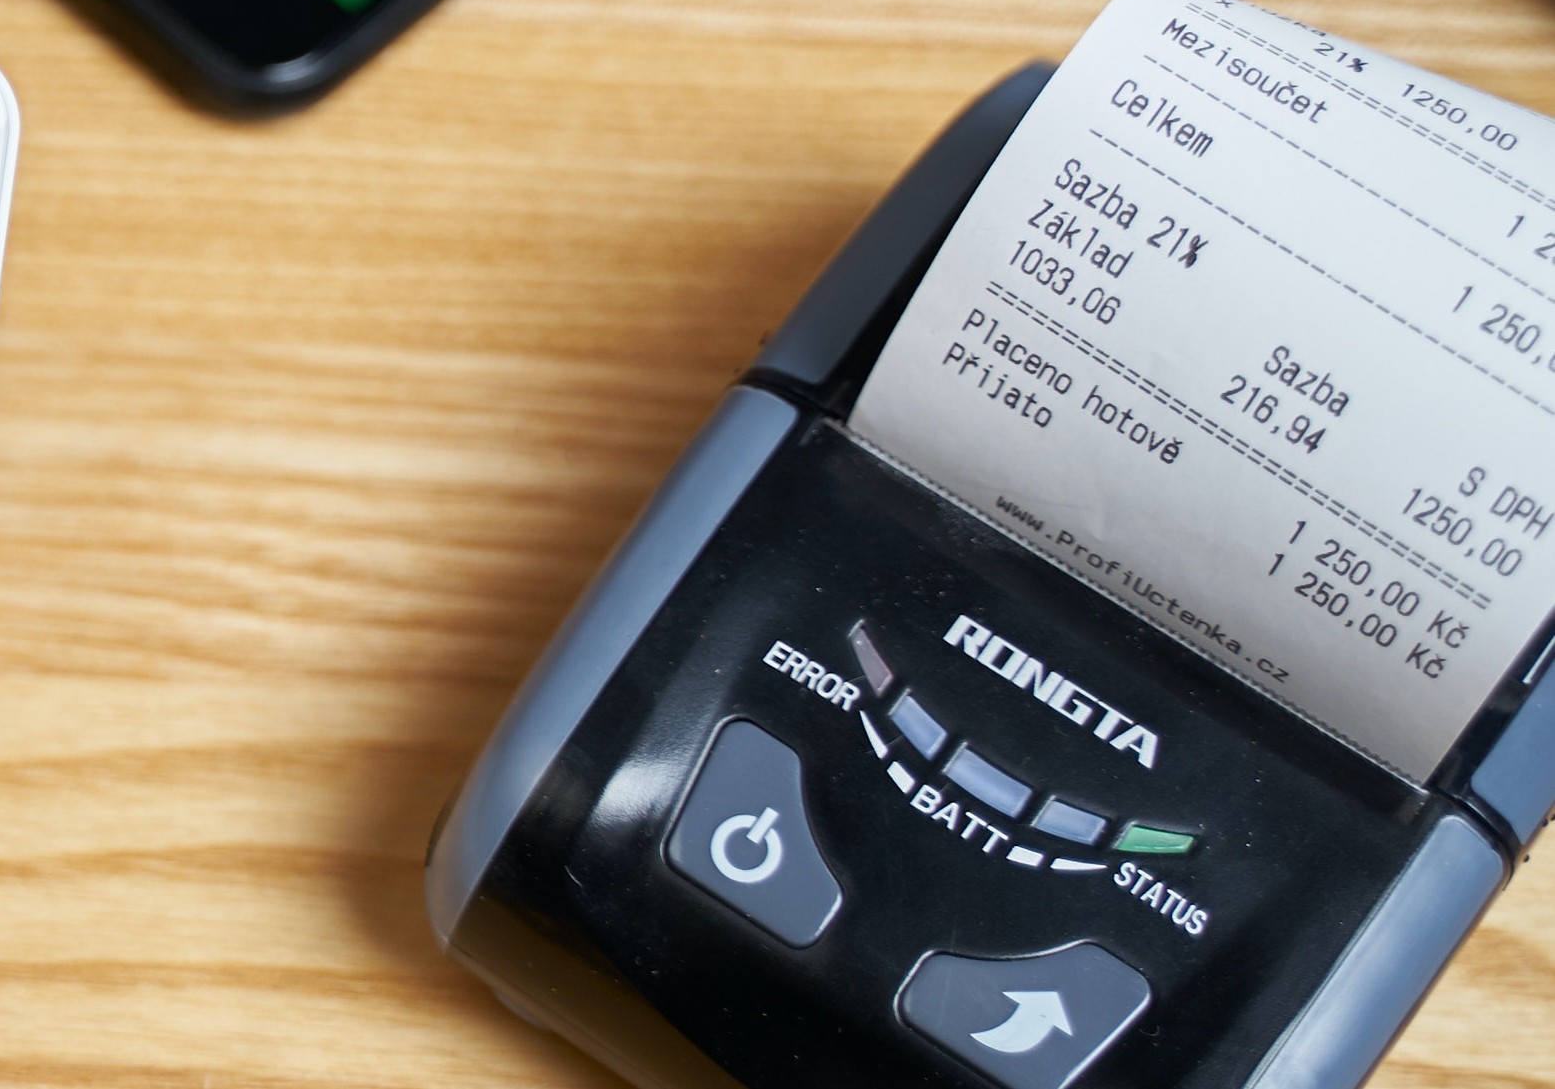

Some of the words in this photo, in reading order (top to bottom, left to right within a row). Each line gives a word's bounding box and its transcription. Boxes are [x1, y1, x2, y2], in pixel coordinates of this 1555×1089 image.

[1162, 18, 1329, 123] Mezisoučet
[1313, 42, 1369, 73] 21%
[1401, 83, 1519, 152] 1250,00
[1054, 158, 1139, 230] Sazba
[1146, 215, 1209, 268] 21%
[1110, 79, 1215, 157] Celkem
[1452, 285, 1473, 313] 1
[1007, 240, 1122, 325] 1033,06
[1220, 375, 1327, 454] 216,94
[1402, 488, 1524, 577] 1250,00
[1027, 199, 1134, 279] Základ
[1263, 345, 1350, 416] Sazba
[1458, 466, 1486, 497] S
[1489, 486, 1555, 540] DPH
[943, 342, 1053, 429] Přijato
[1294, 572, 1398, 648] 250,00
[1405, 643, 1447, 679] Kč
[961, 308, 1073, 395] Placeno
[1081, 385, 1185, 465] hotově
[1314, 539, 1421, 617] 250,00
[1426, 610, 1470, 649] Kč
[762, 640, 862, 712] ERROR
[943, 615, 1160, 769] RONGTA
[909, 784, 1010, 855] BATT
[1113, 862, 1209, 937] STATUS
